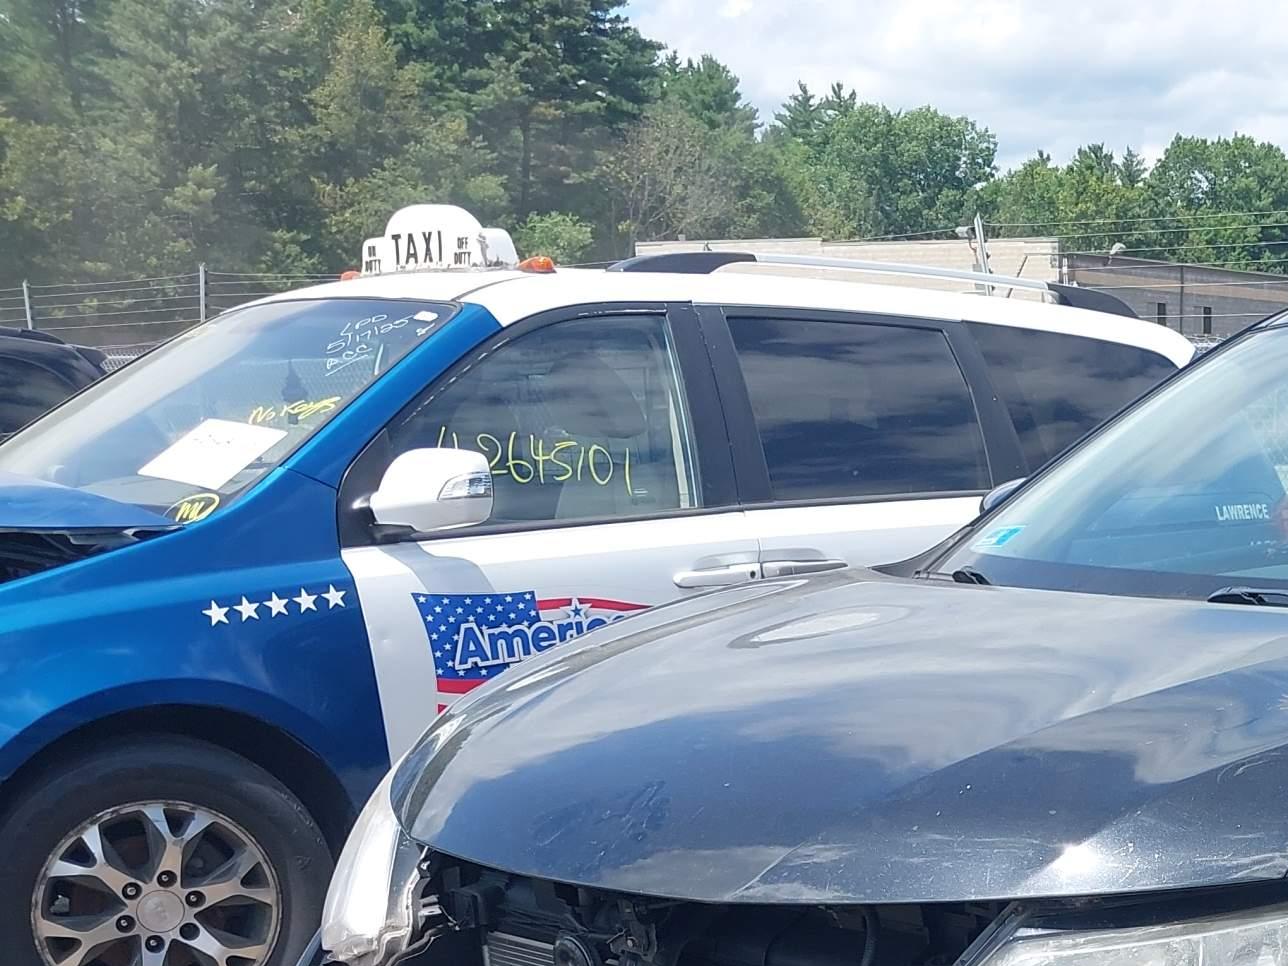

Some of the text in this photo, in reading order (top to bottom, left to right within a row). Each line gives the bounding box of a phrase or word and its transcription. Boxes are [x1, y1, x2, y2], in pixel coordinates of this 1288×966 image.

[391, 230, 443, 265] TAXI
[454, 252, 471, 265] DUTY
[1215, 503, 1270, 521] LAWRENCE
[455, 613, 626, 669] Ameri
